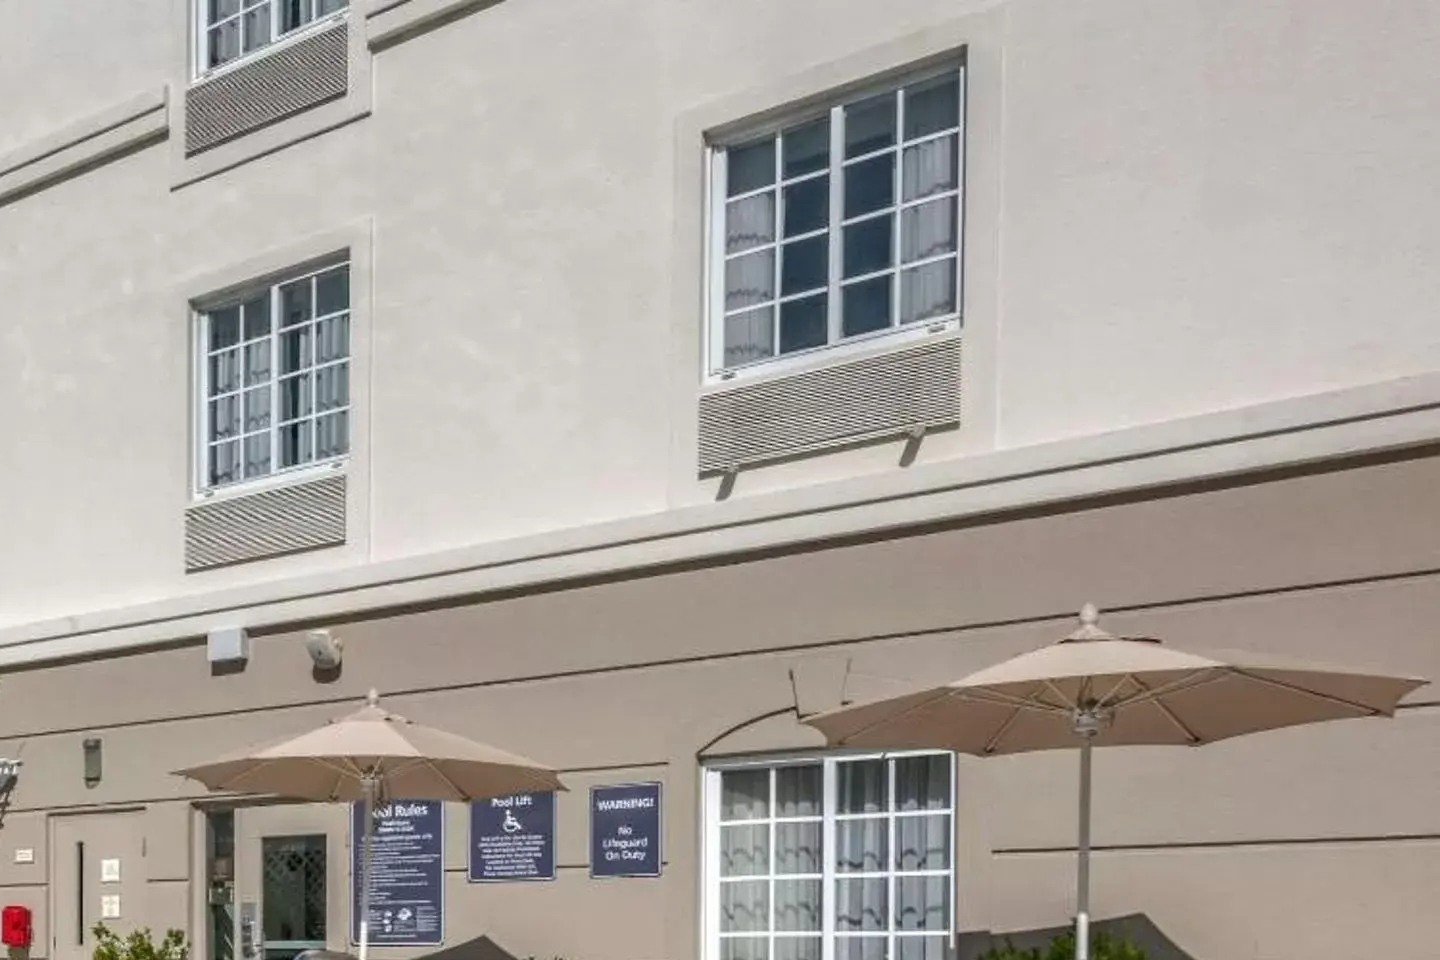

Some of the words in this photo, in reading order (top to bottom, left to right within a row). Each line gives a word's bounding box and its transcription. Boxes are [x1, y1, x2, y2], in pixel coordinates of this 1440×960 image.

[491, 796, 513, 808] Pool
[515, 795, 533, 806] Lift
[395, 803, 428, 817] Rules
[618, 827, 632, 835] No
[602, 837, 648, 849] Lifeguard
[605, 851, 620, 861] On
[621, 850, 646, 861] Duty
